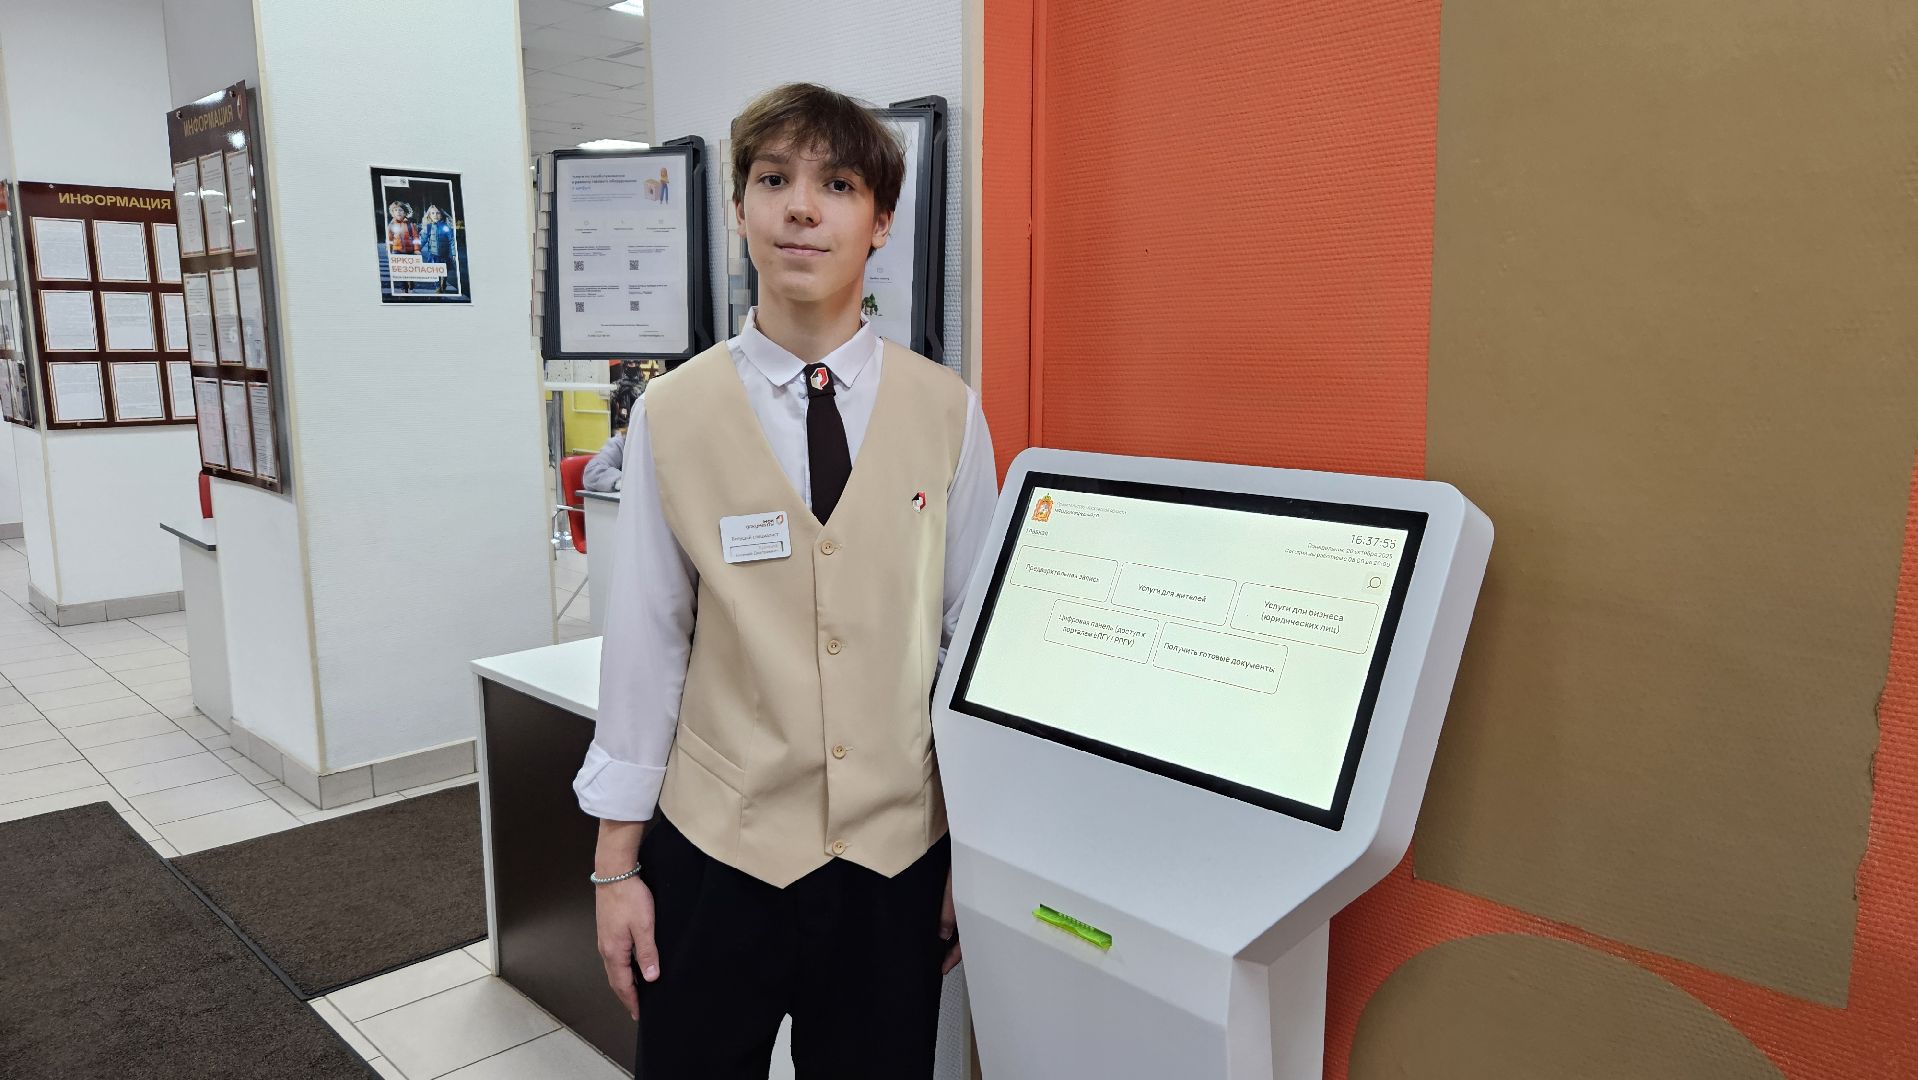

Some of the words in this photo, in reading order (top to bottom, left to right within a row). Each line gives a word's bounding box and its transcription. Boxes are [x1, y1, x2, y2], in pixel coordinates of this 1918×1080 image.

[183, 105, 233, 137] ИНФОРМАЦИЯ
[58, 192, 172, 210] ИНФОРМАЦИЯ
[392, 265, 445, 274] БЕЗОПАСНО
[1351, 534, 1397, 550] 16:37:55
[1026, 563, 1078, 578] Предварительная
[1078, 574, 1100, 583] запись
[1138, 584, 1160, 595] Услуги
[1160, 590, 1174, 598] для
[1175, 592, 1207, 602] жителей
[1264, 600, 1291, 612] Услуги
[1308, 610, 1344, 622] бизнеса
[1058, 614, 1090, 626] Цифровая
[1090, 621, 1114, 631] панель
[1261, 612, 1318, 630] (юридических
[1320, 624, 1340, 634] лиц)
[1164, 642, 1198, 656] Получить
[1198, 651, 1230, 663] готовые
[1230, 658, 1276, 673] документы
